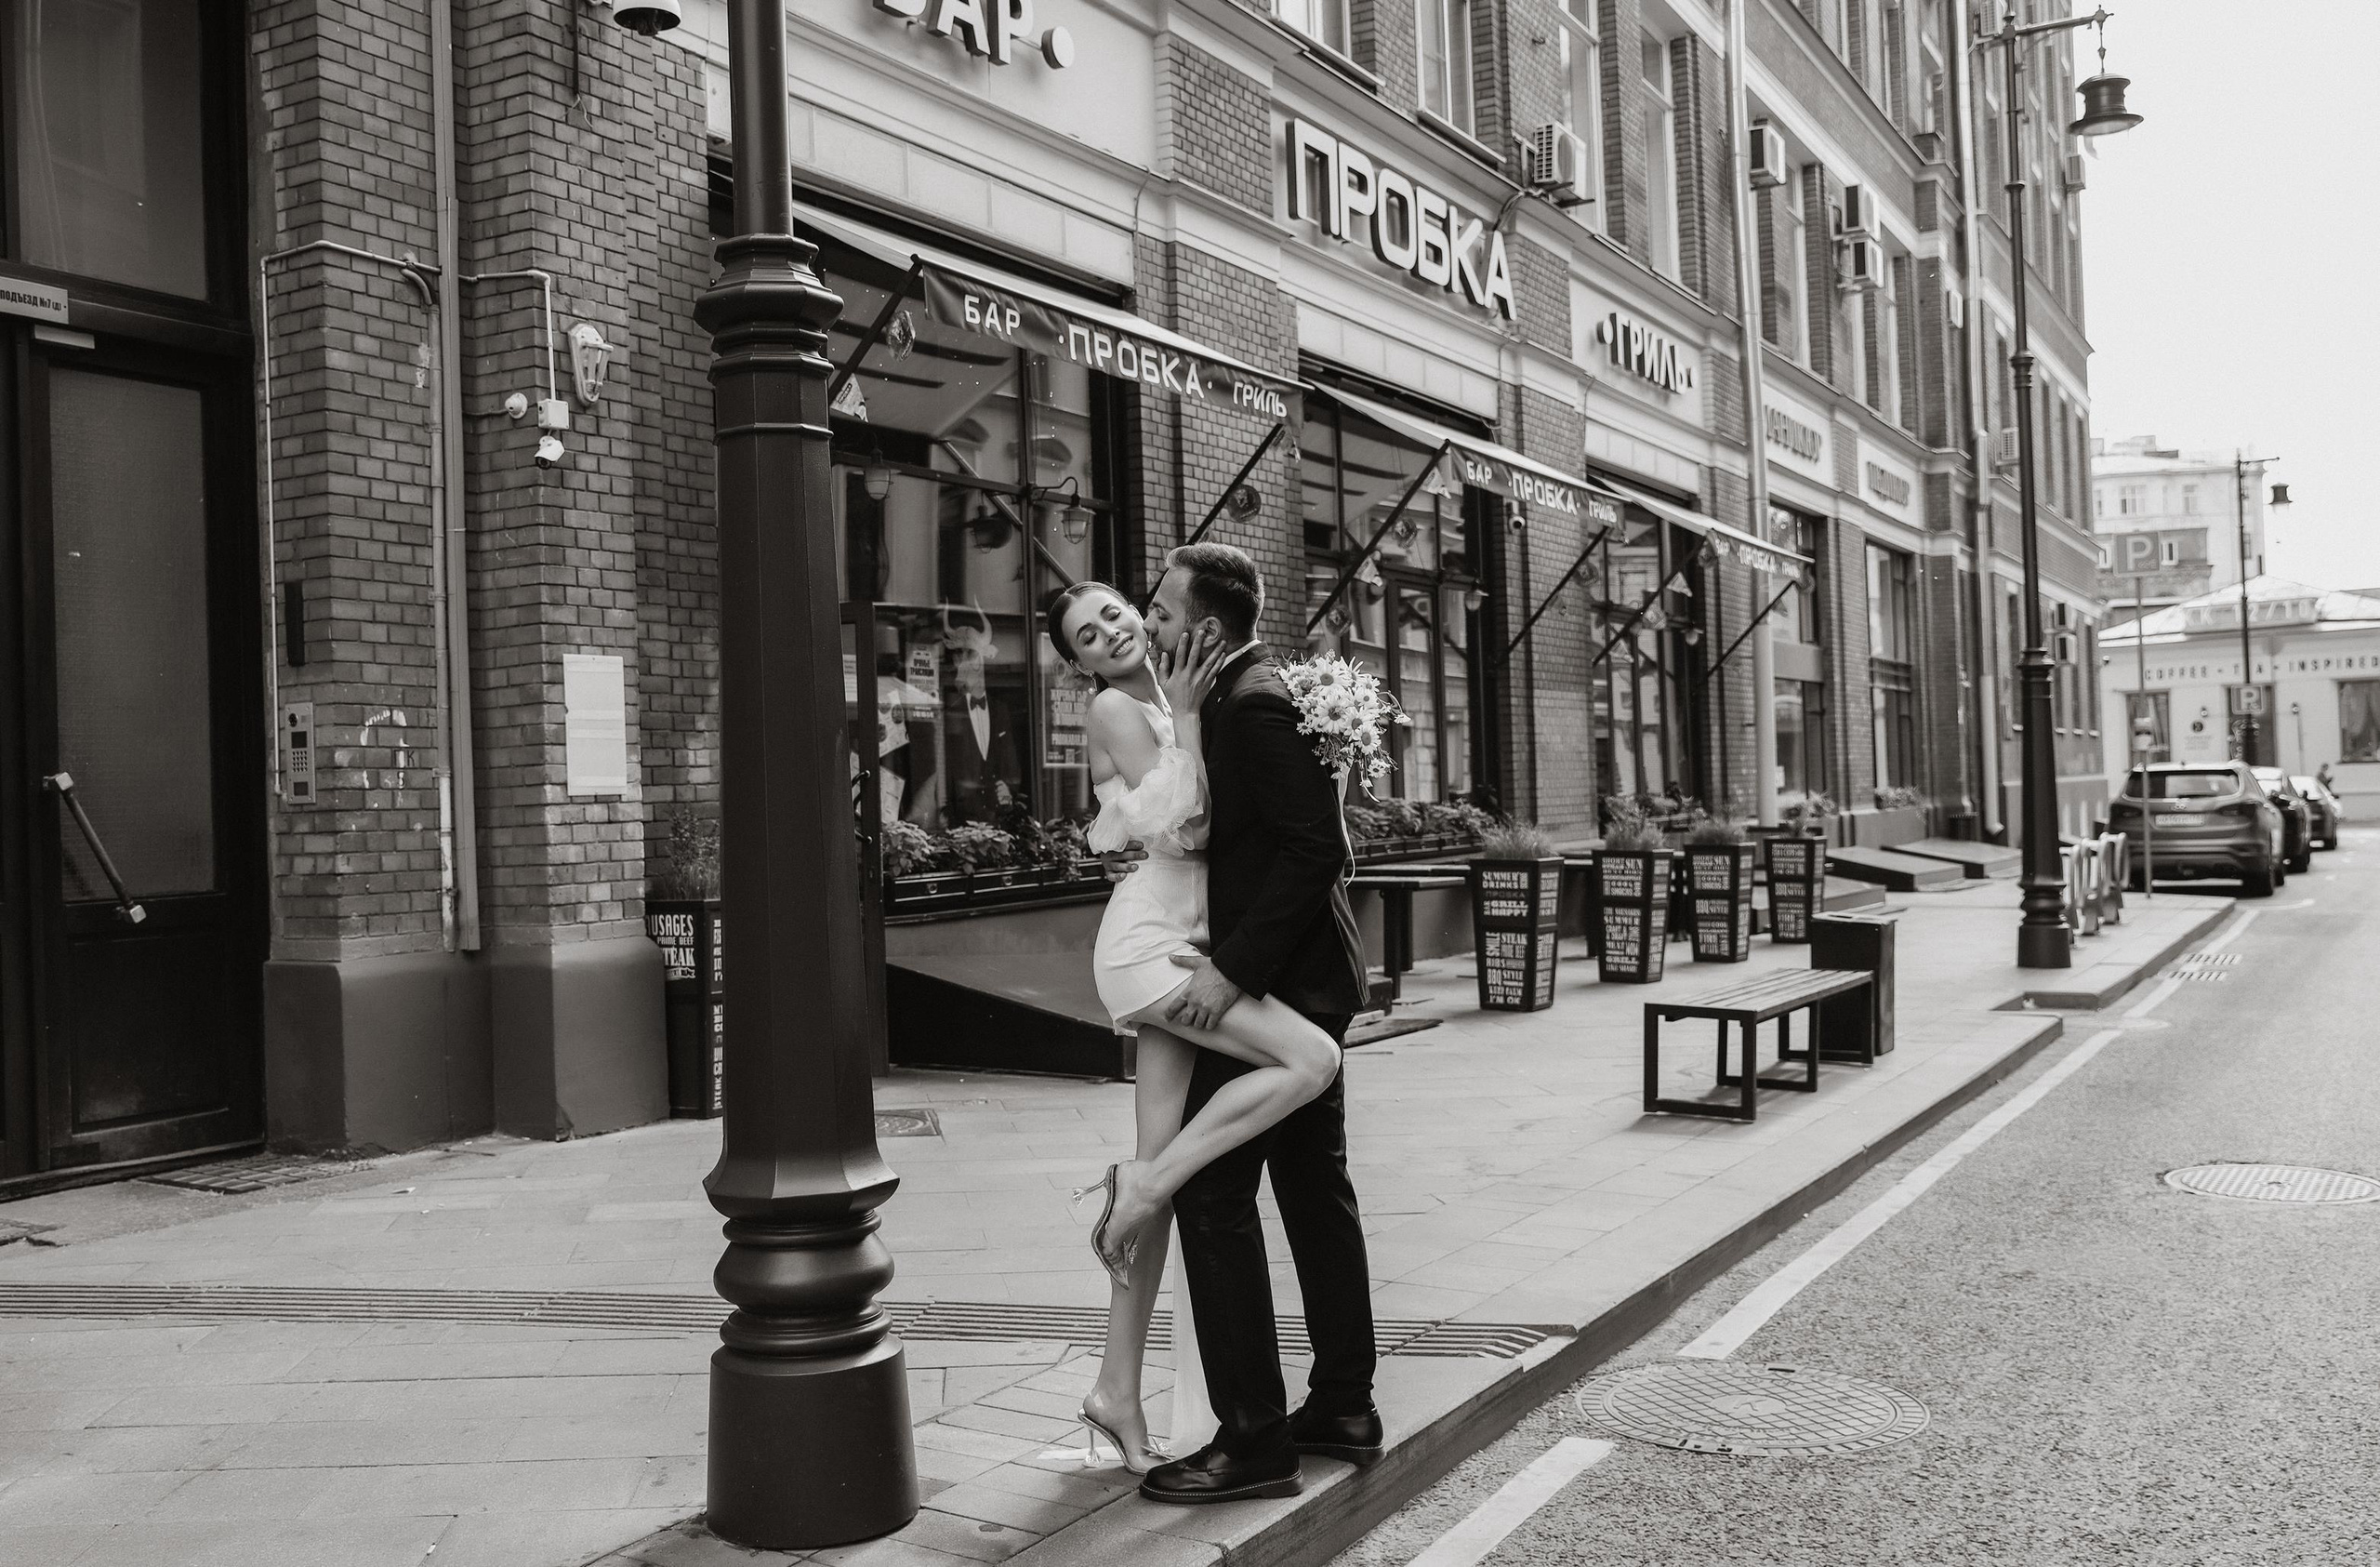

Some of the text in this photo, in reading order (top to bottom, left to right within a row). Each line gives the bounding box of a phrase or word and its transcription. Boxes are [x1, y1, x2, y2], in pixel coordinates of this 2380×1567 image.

[1287, 117, 1518, 321] ПРОБКА
[0, 289, 38, 307] ПОДЪЕЗД
[963, 294, 1288, 418] БАР ПРОБКА ГРИЛЬ
[1610, 312, 1688, 394] ГРИЛЬ
[1466, 460, 1617, 523] БАР ПРОБКА ГРИЛЬ
[2126, 535, 2152, 570] P
[2234, 662, 2263, 678] TA
[1482, 881, 1518, 889] DRINKS
[1490, 900, 1528, 909] GRILL
[1491, 909, 1527, 917] HAPPY
[1501, 933, 1527, 945] STEAK
[663, 948, 695, 966] TEAK
